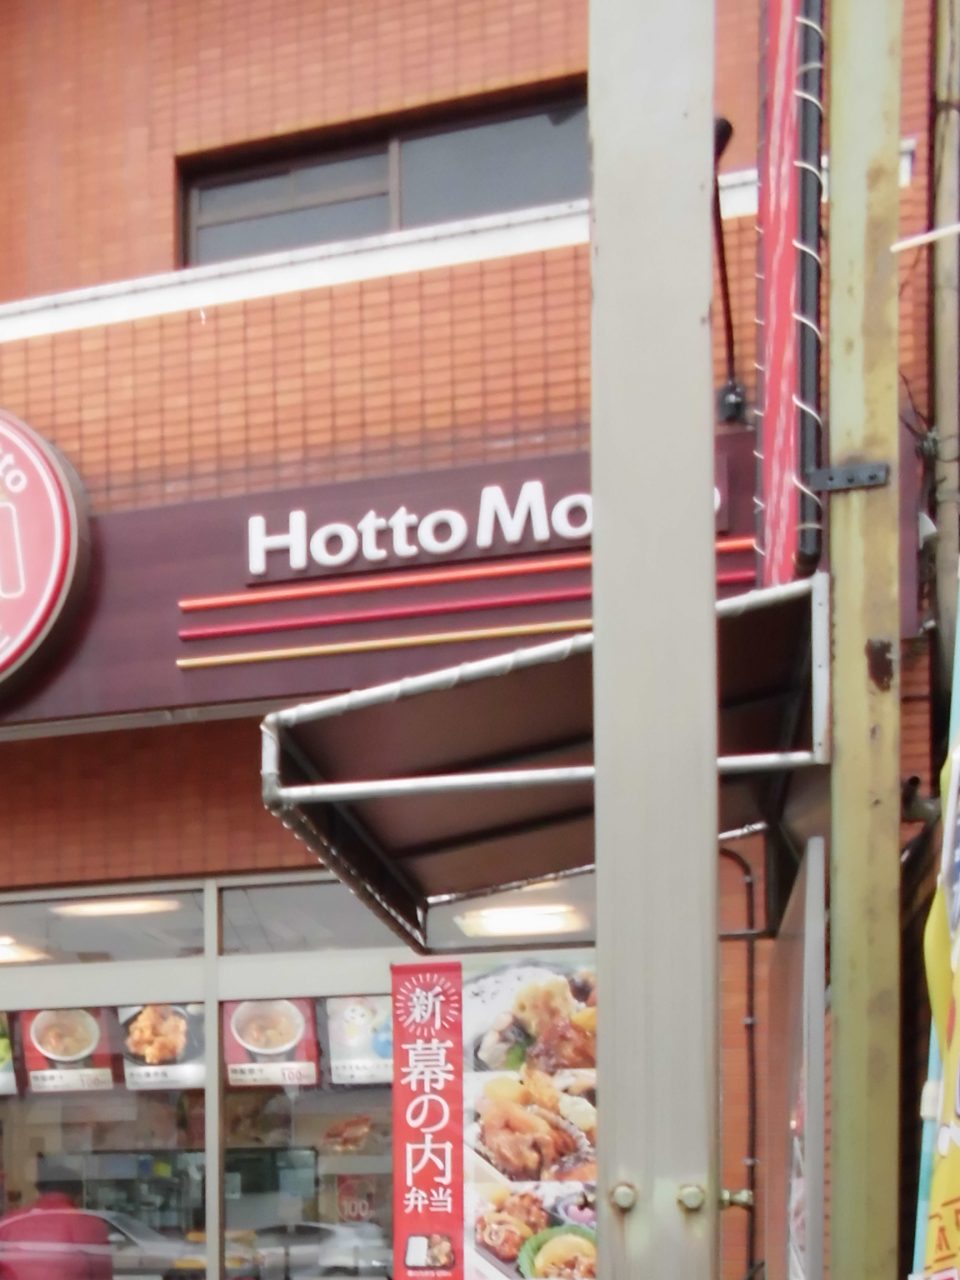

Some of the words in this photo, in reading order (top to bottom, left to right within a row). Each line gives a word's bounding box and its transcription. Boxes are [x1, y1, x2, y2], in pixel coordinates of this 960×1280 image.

[248, 480, 721, 575] HottoMo
[409, 985, 446, 1030] 新
[400, 1037, 455, 1187] 幕の内
[403, 1186, 453, 1214] 弁当
